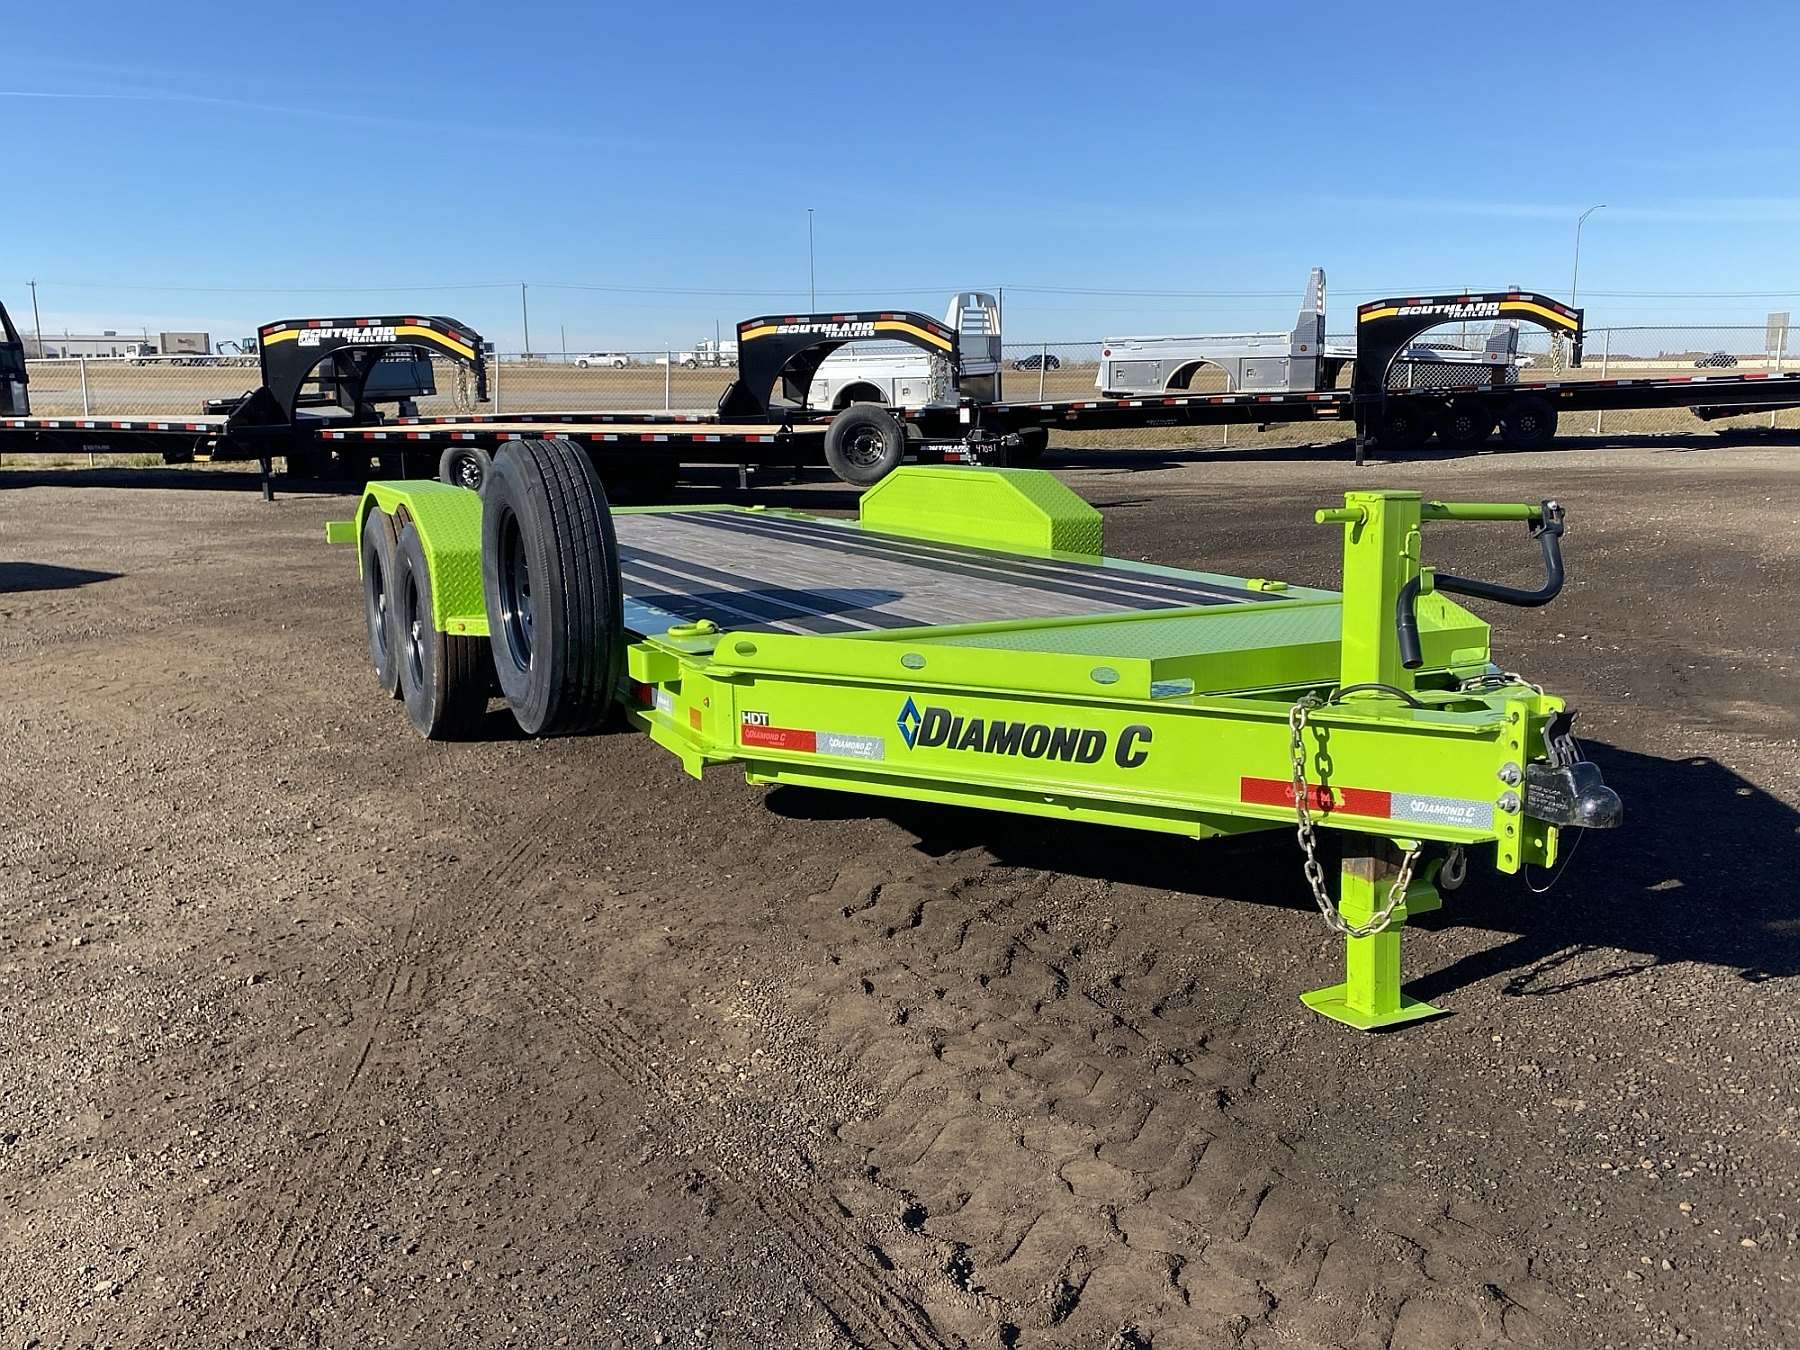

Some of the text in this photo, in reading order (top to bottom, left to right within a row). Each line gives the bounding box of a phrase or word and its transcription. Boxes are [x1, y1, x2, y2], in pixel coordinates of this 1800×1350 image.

[1398, 302, 1499, 316] SOUTHLAND
[1448, 309, 1499, 319] TRAILERS
[299, 326, 395, 339] SOUTHLAND
[776, 321, 875, 334] SOUTHLAND
[346, 334, 397, 344] TRAILERS
[825, 330, 874, 339] TRAILERS
[741, 711, 768, 726] HDT
[917, 706, 1153, 768] DIAMOND C
[1416, 801, 1475, 818] DIAMOND C
